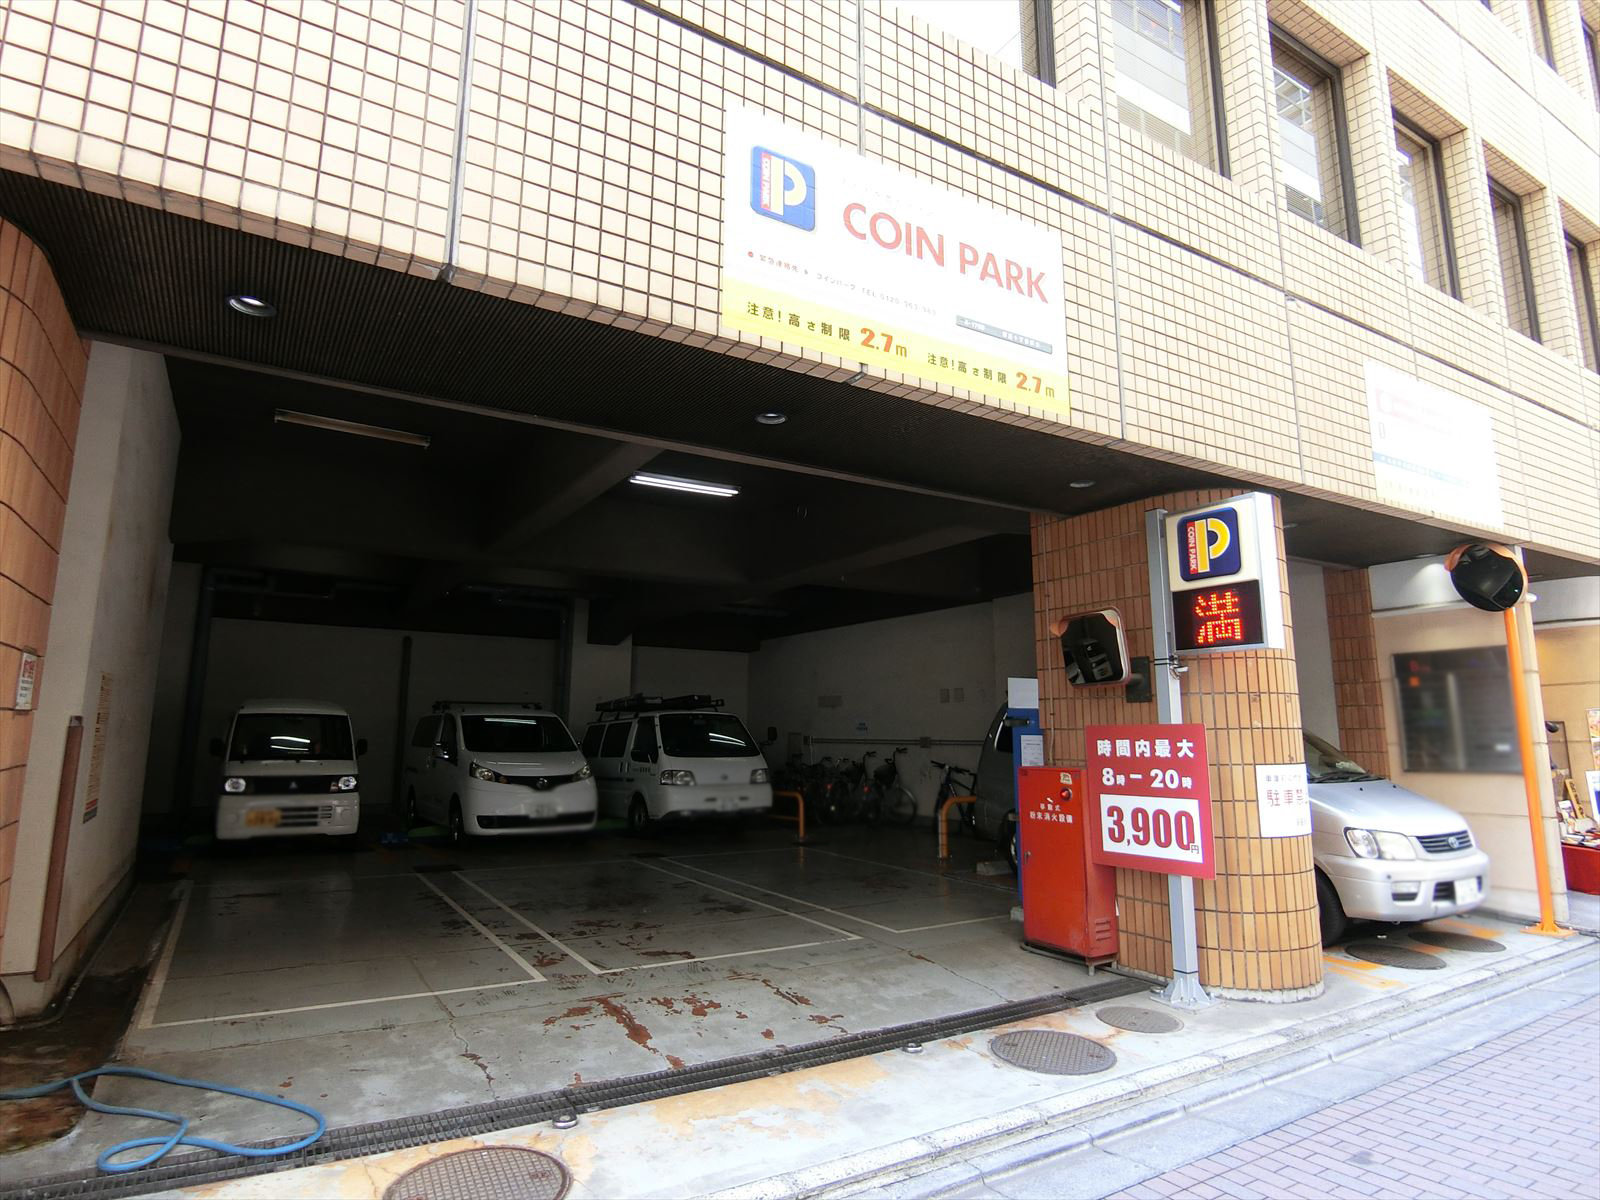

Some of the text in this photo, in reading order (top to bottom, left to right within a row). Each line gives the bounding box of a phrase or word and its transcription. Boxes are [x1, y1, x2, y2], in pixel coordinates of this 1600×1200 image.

[842, 202, 1049, 304] COIN PARK
[861, 286, 877, 299] TEL
[1186, 526, 1198, 572] COIN PARK
[1194, 517, 1231, 575] P
[1195, 590, 1242, 644] 満
[1096, 739, 1195, 758] 時間内最大
